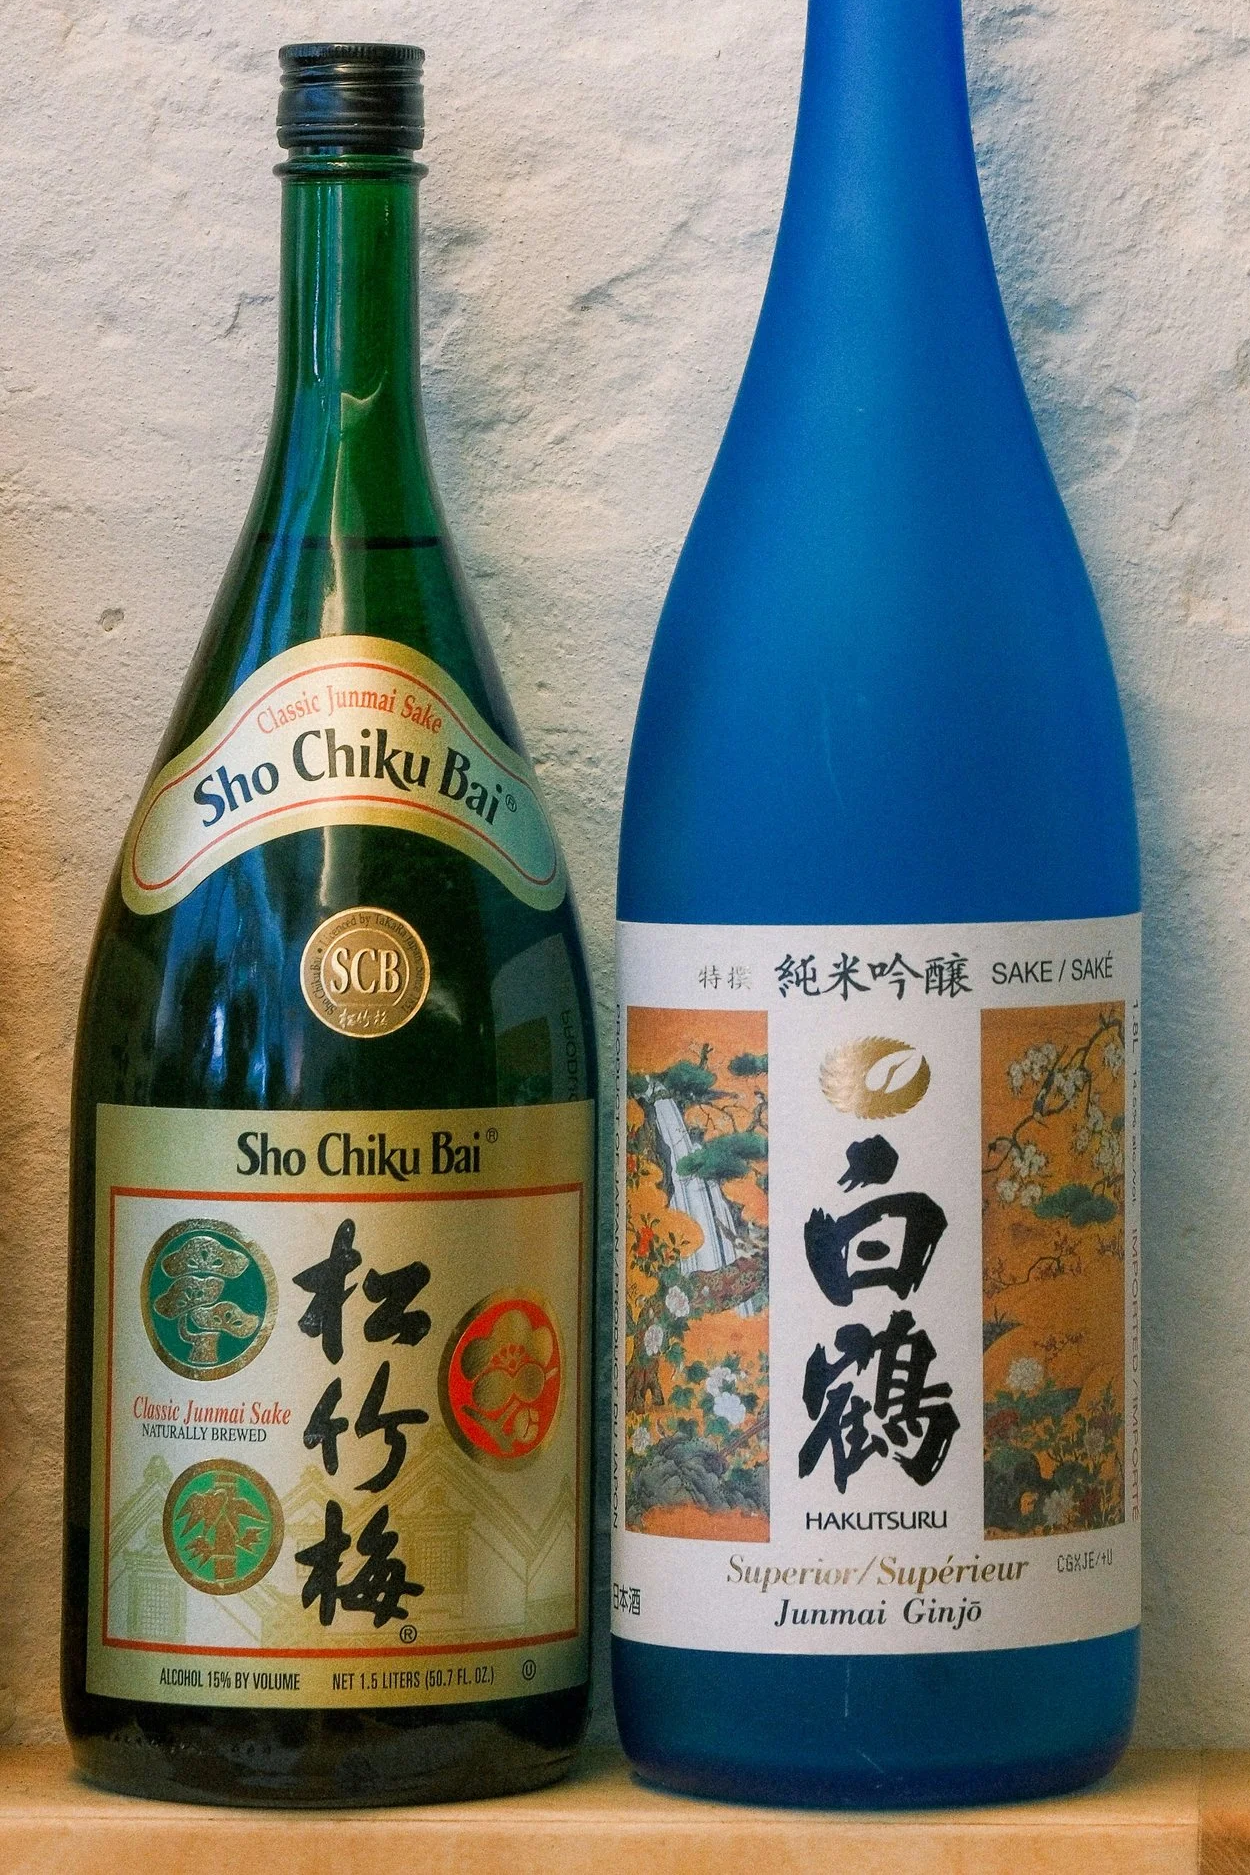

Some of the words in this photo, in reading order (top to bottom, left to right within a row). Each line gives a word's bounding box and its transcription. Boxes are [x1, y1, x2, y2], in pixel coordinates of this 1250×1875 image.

[257, 691, 321, 734] Classic
[326, 685, 398, 716] Junmai
[401, 692, 443, 734] Sake
[193, 765, 280, 827] Sho
[292, 728, 430, 792] Chiku
[330, 947, 401, 994] SCB
[992, 960, 1052, 984] SAKE
[1072, 949, 1114, 982] SAKÉ
[237, 1132, 307, 1177] Sho
[317, 1130, 421, 1183] Chiku
[798, 1134, 960, 1494] 白鶴
[132, 1395, 180, 1421] Classic
[183, 1400, 246, 1425] Junmai
[250, 1403, 292, 1425] Sake
[292, 1218, 432, 1629] 松竹梅
[141, 1423, 209, 1441] NATURALLY
[210, 1427, 267, 1443] BREWED
[805, 1510, 948, 1531] HAKUTSURU
[613, 1582, 641, 1616] 日本酒
[774, 1599, 888, 1628] Junmai
[903, 1597, 983, 1630] Ginjō
[159, 1667, 203, 1687] ALCOHOL
[208, 1671, 232, 1689] 15%
[235, 1672, 251, 1690] BY
[253, 1672, 301, 1691] VOLUME
[332, 1672, 356, 1691] NET
[360, 1671, 378, 1689] 1.5
[383, 1670, 421, 1690] LITERS
[425, 1667, 454, 1690] (50.7
[457, 1668, 475, 1686] FL.
[476, 1665, 495, 1686] OZ.)
